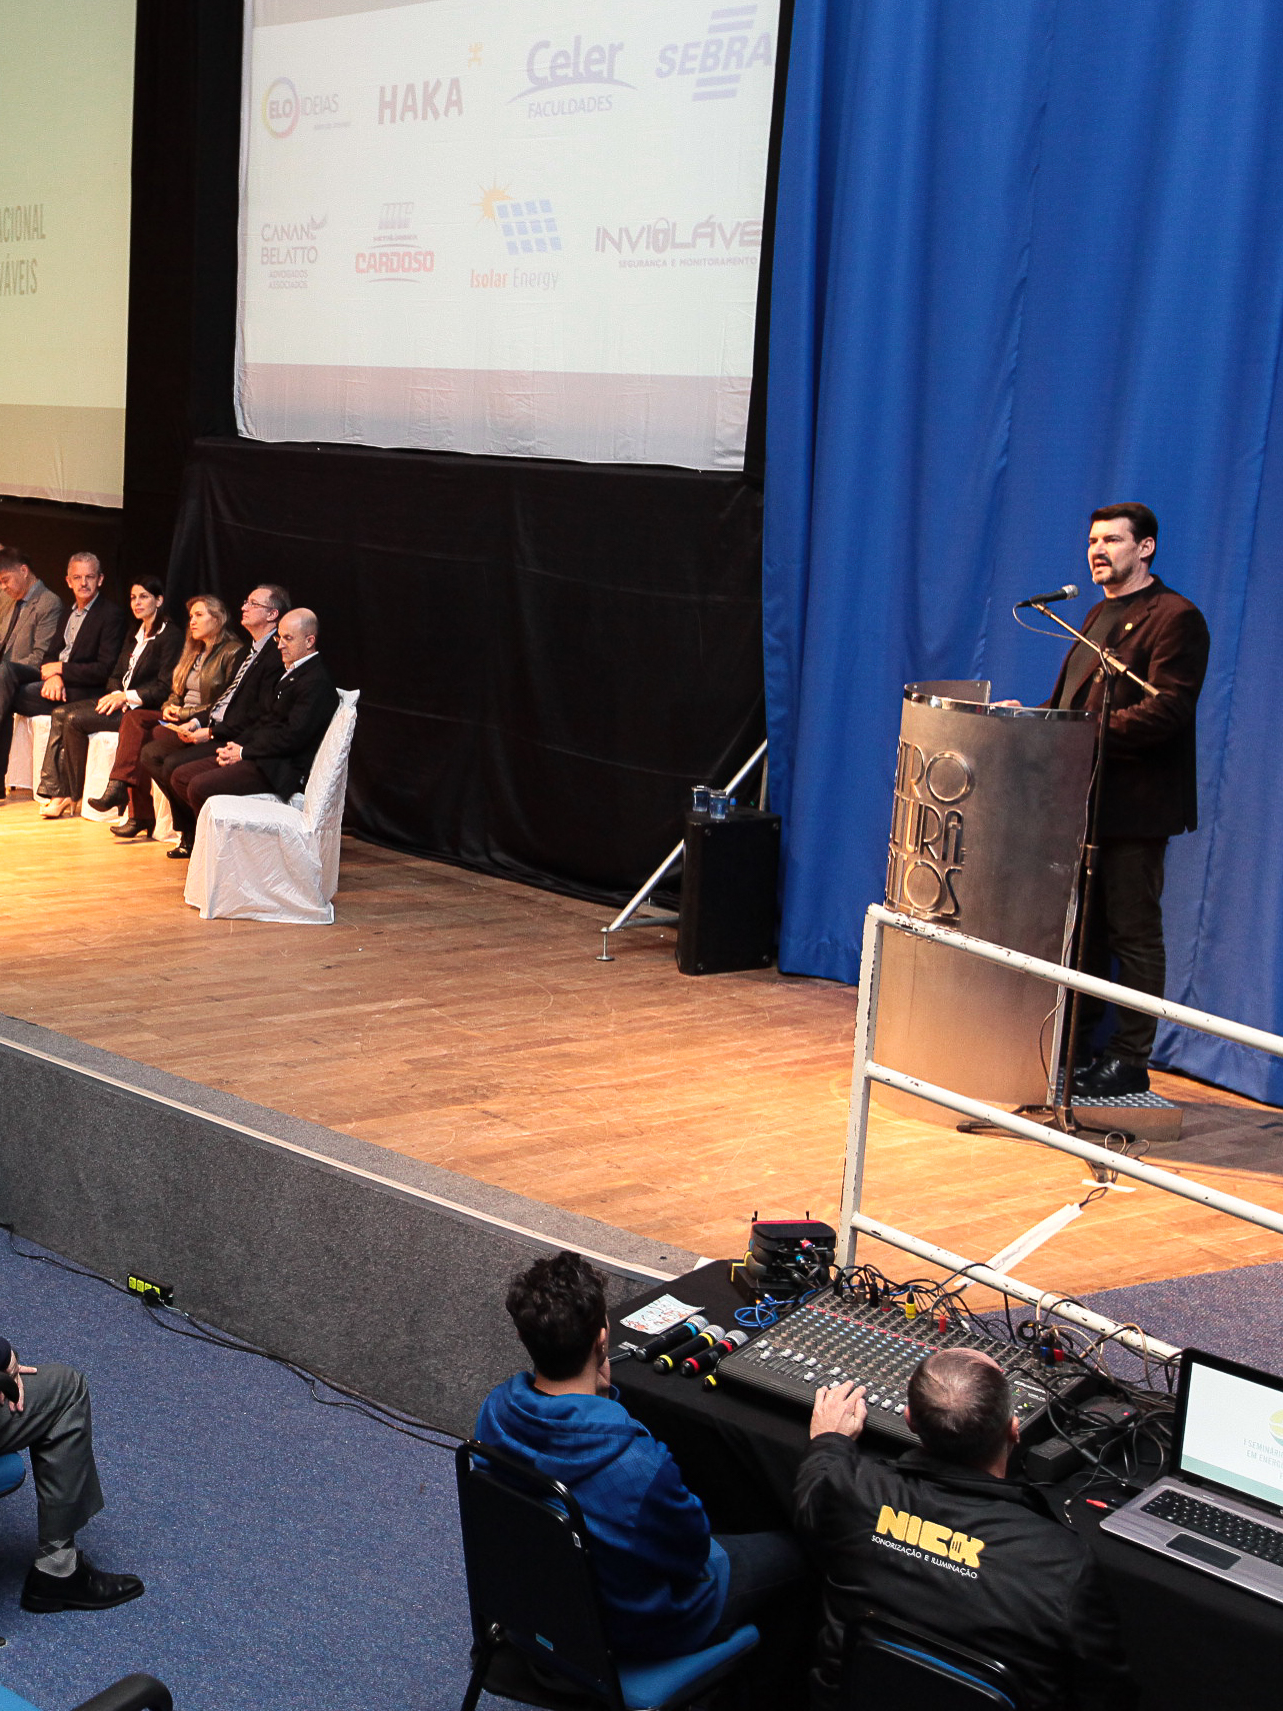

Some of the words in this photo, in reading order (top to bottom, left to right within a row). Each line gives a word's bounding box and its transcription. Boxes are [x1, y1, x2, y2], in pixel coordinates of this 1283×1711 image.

[526, 34, 625, 86] Celer
[269, 99, 293, 119] ELO
[378, 76, 465, 125] HAKA
[527, 94, 613, 119] FACULDADES
[260, 245, 318, 265] BELATTO
[354, 250, 435, 274] CARDOSO
[618, 257, 667, 269] SEGURANÇA
[679, 255, 758, 267] MONITORAMENTO
[470, 269, 508, 288] Isolar
[513, 267, 560, 291] Energy
[875, 1504, 985, 1569] NICK
[871, 1534, 922, 1559] SONORIZAÇÃO
[931, 1557, 978, 1579] ILUMINAÇÃO
